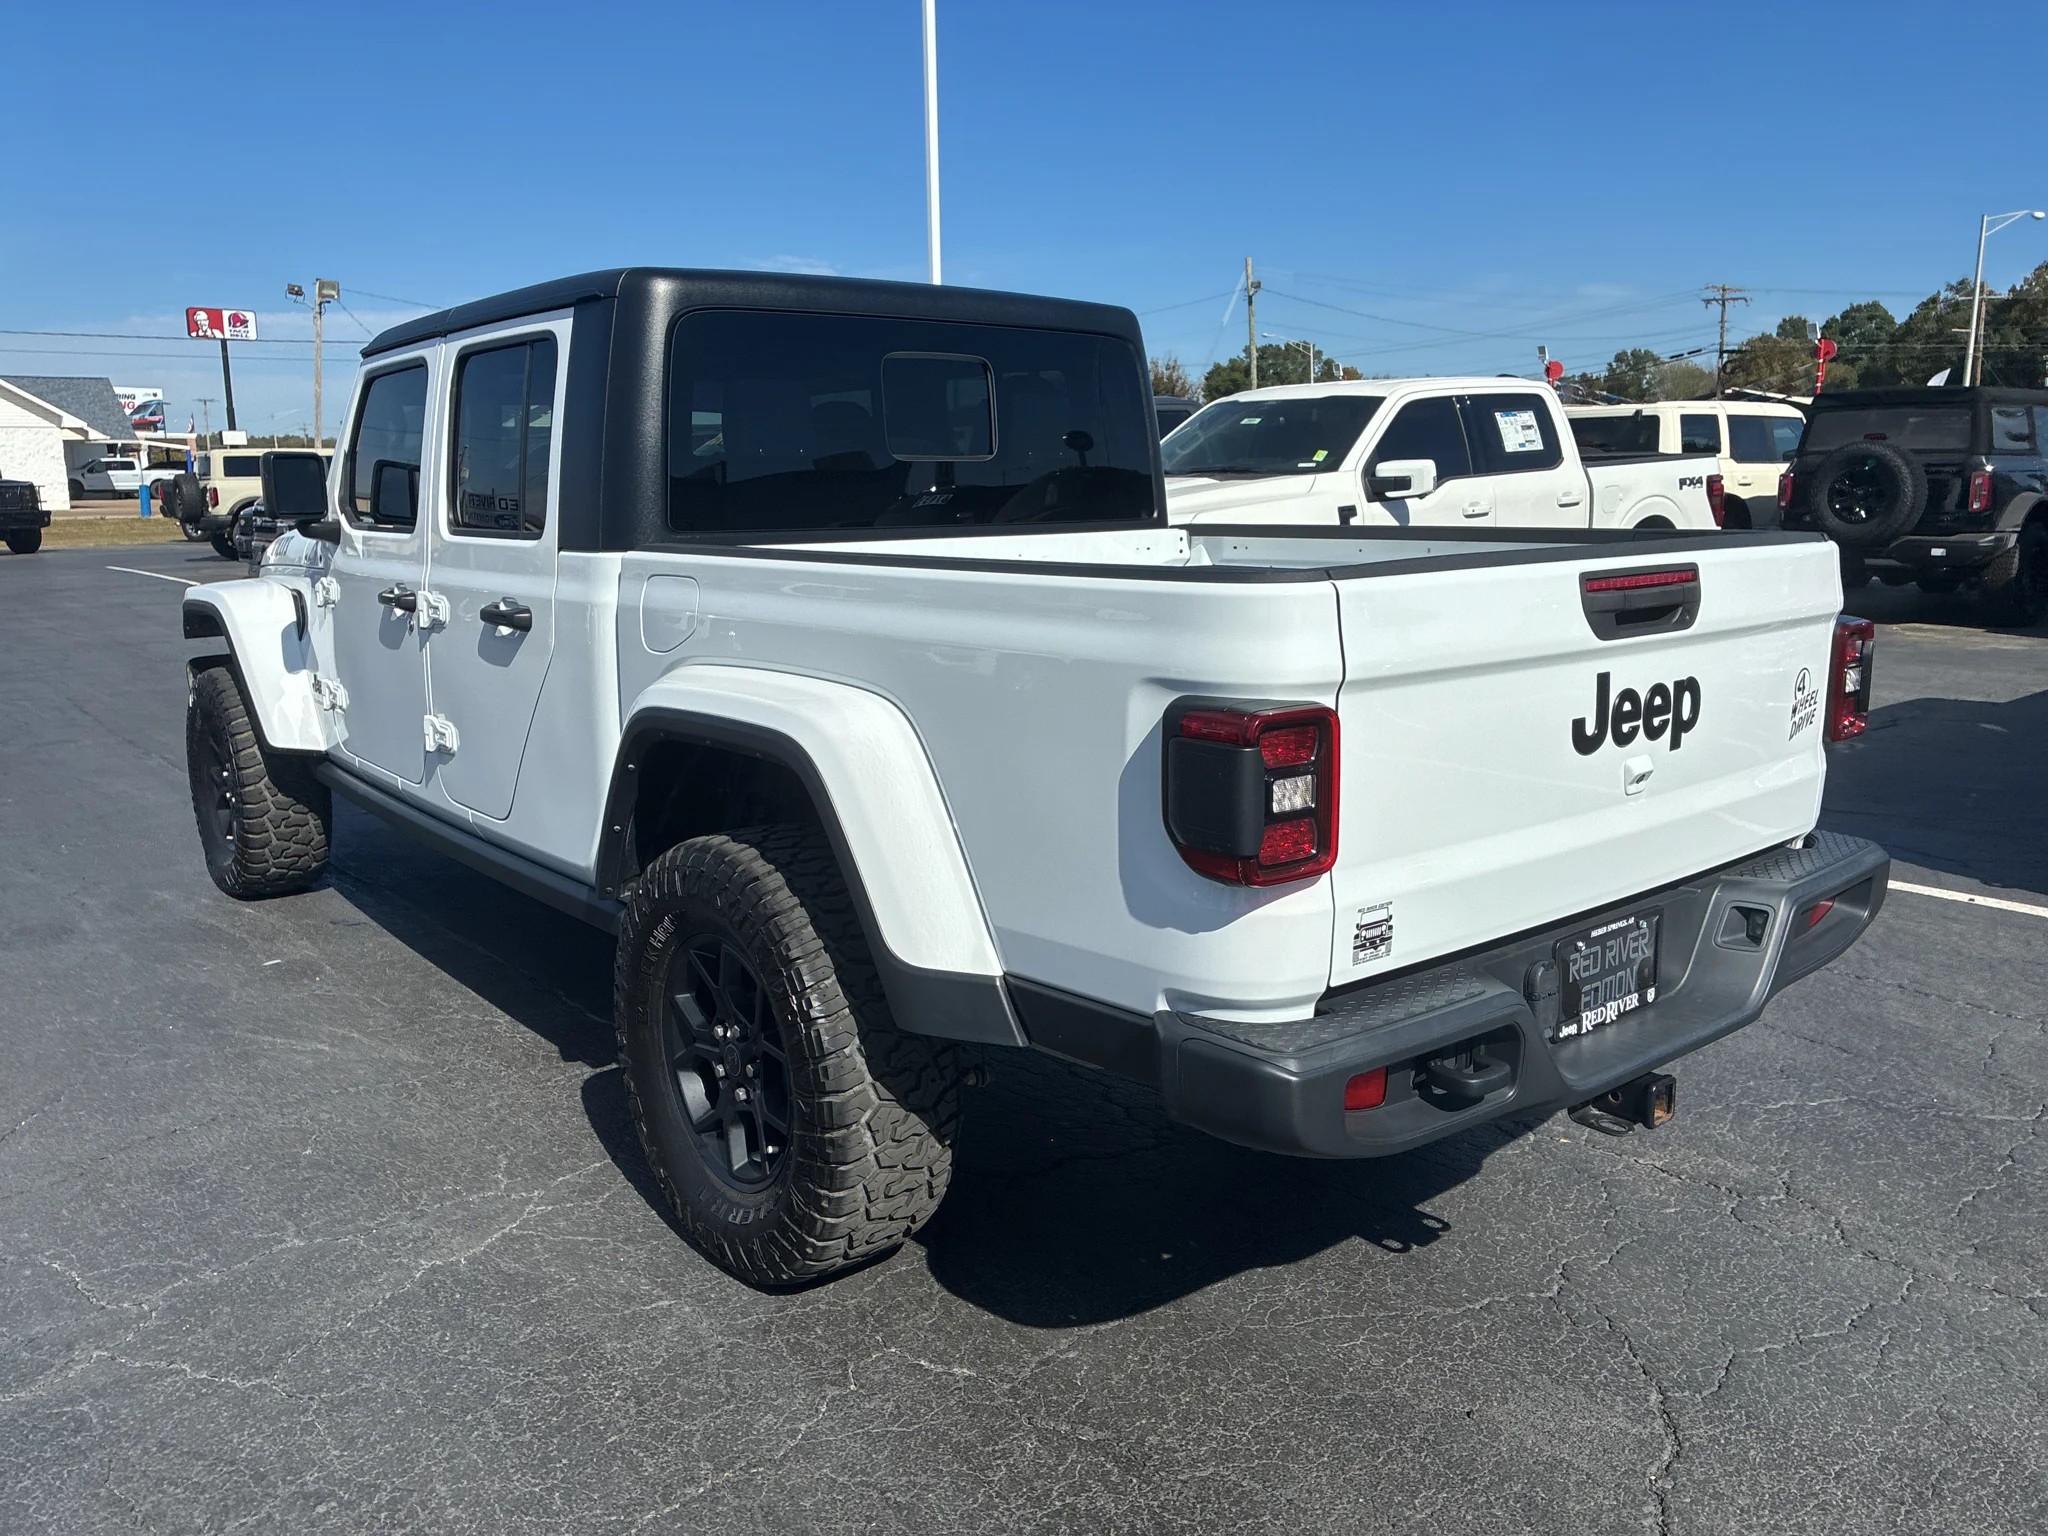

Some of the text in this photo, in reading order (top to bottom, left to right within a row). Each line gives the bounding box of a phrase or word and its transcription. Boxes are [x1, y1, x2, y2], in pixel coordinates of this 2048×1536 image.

[1679, 476, 1704, 490] FX4
[1571, 671, 1701, 756] Jeep
[1790, 688, 1819, 721] WHEEL
[1789, 707, 1817, 742] DRIVE
[1569, 927, 1649, 983] RED RIVER
[1580, 965, 1637, 1011] EDITION
[1559, 1023, 1578, 1038] Jeep
